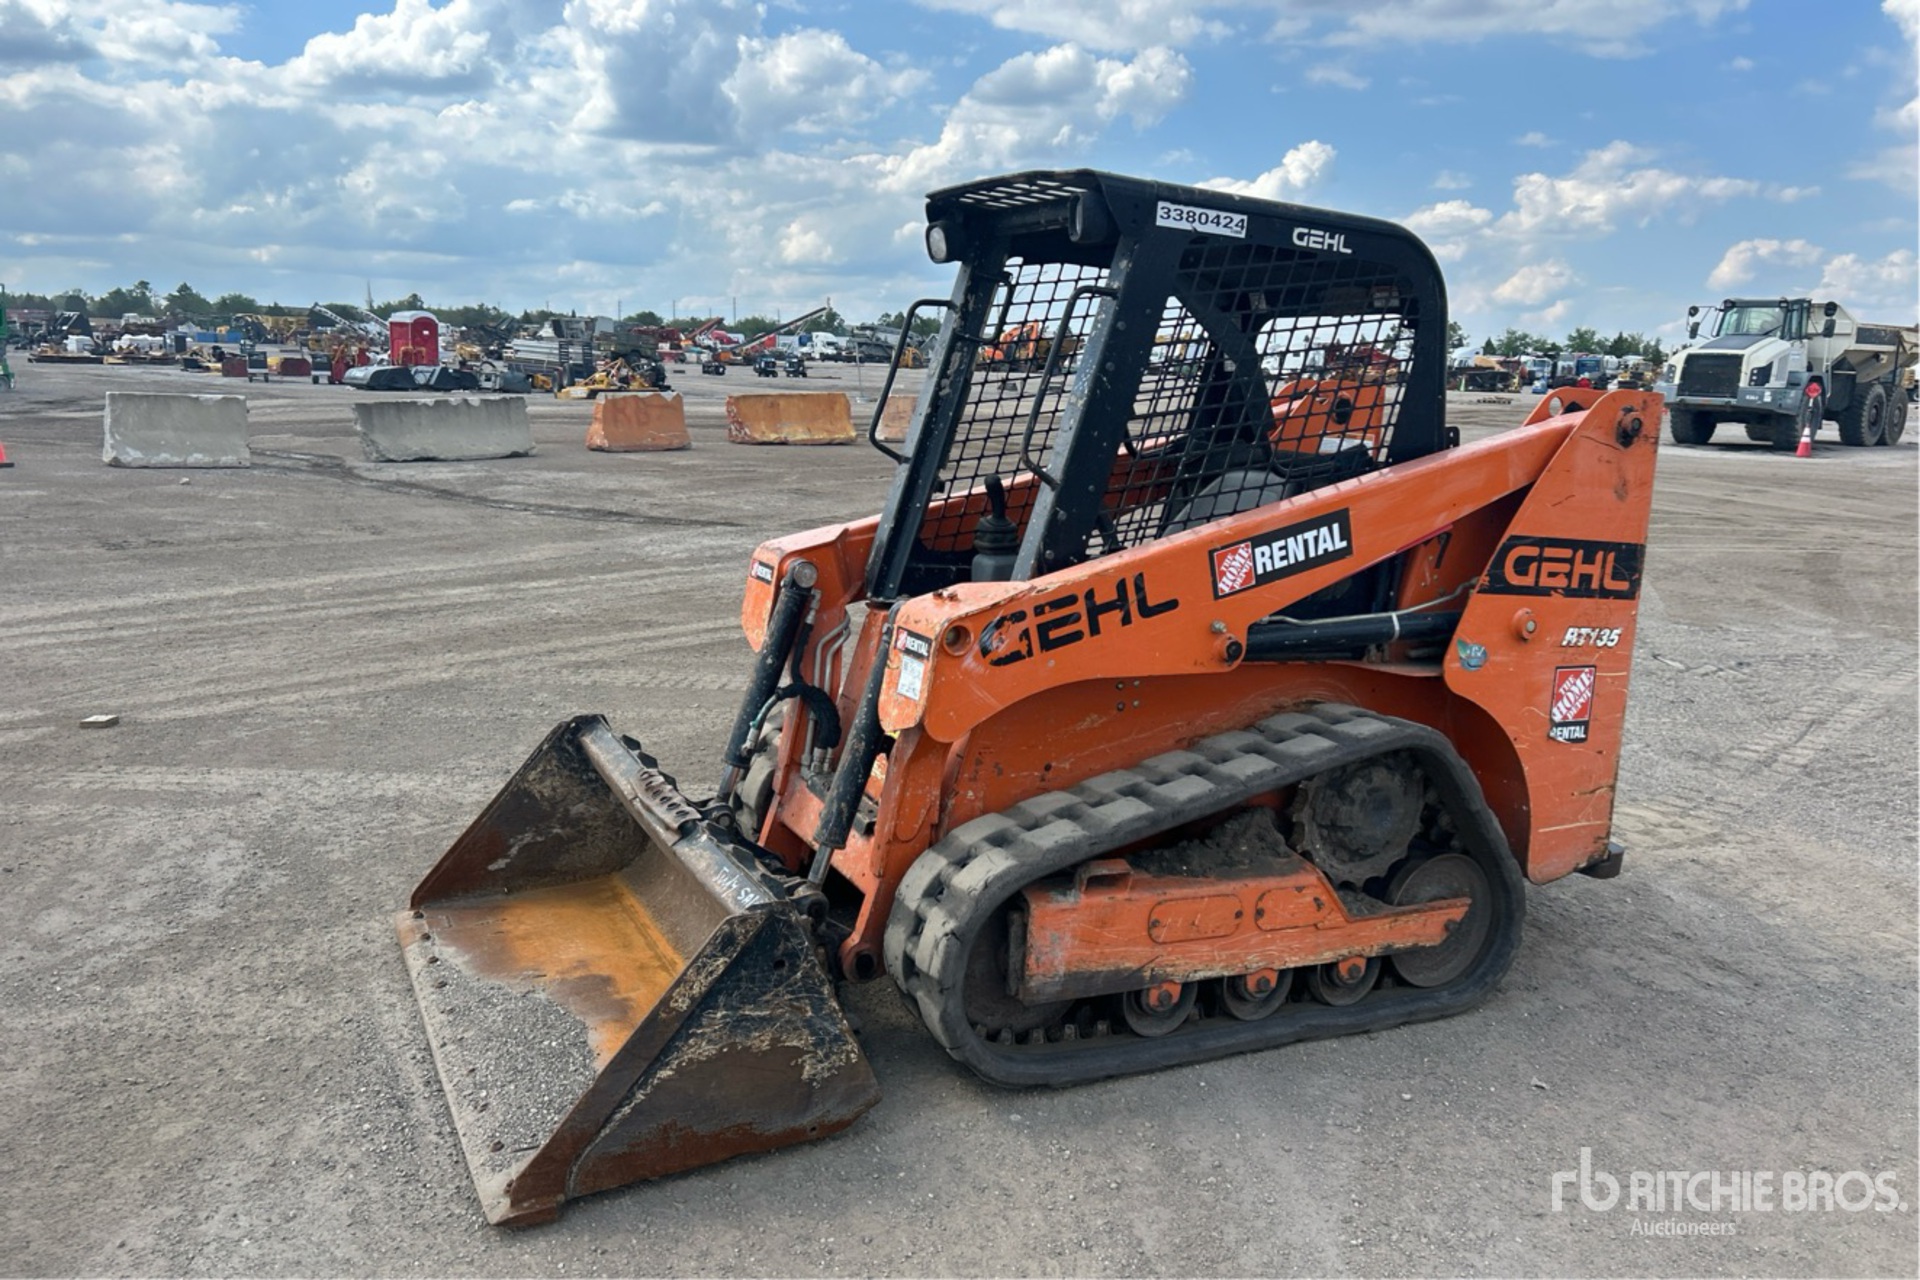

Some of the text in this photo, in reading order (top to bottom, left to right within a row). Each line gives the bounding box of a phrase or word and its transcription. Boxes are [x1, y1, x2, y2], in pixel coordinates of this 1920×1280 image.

[1159, 205, 1246, 232] 3380424
[1292, 226, 1353, 254] GEHL
[1220, 553, 1233, 571] THE
[1254, 521, 1348, 576] RENTAL
[1218, 544, 1250, 592] HOME
[1503, 545, 1630, 591] GEHL
[979, 572, 1180, 667] GEHL
[1561, 626, 1624, 648] RT135
[1552, 669, 1593, 721] HOME
[1559, 674, 1576, 695] THE
[1549, 725, 1587, 740] RENTAL
